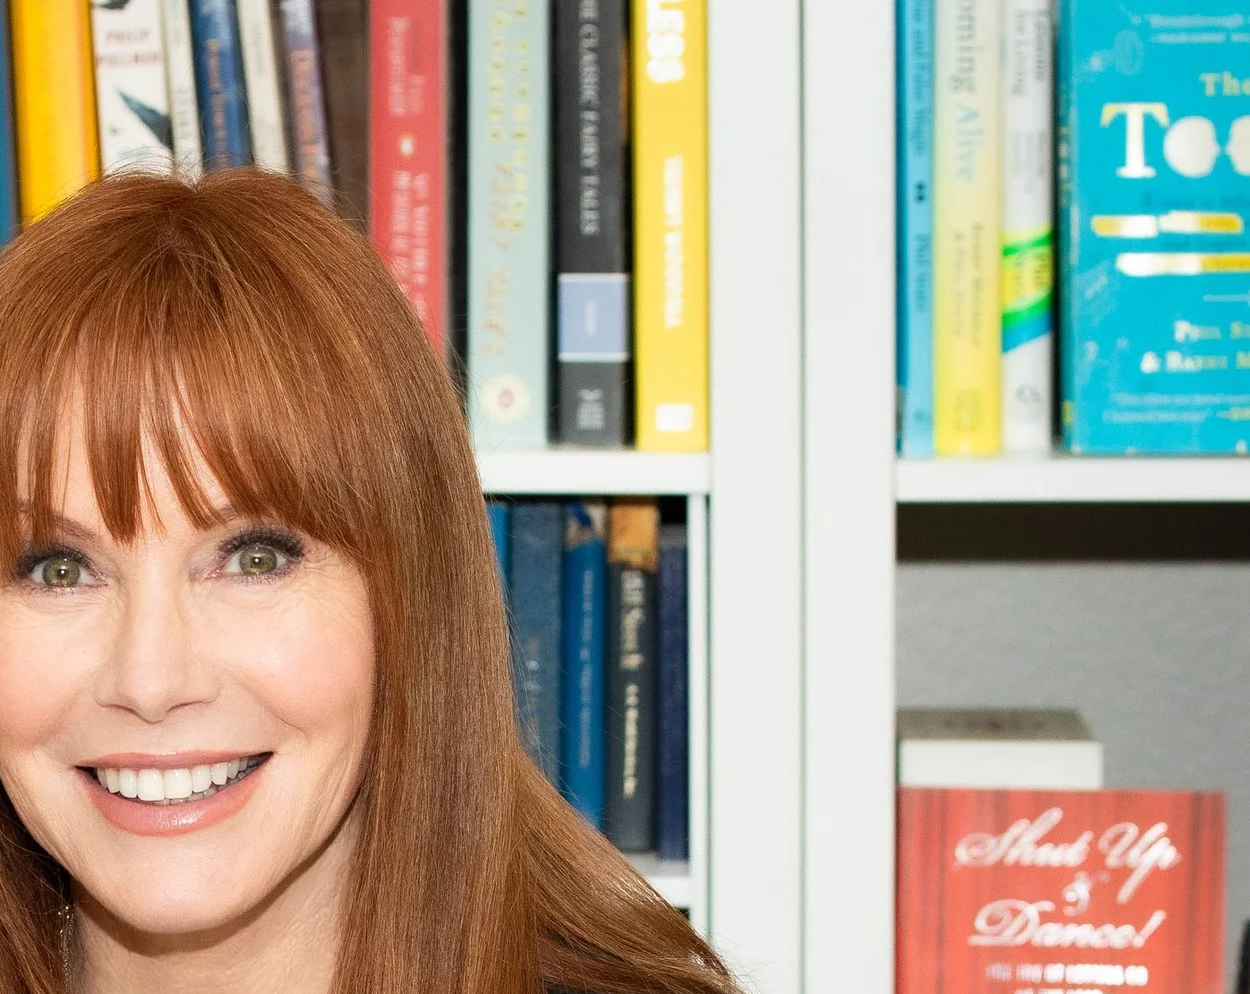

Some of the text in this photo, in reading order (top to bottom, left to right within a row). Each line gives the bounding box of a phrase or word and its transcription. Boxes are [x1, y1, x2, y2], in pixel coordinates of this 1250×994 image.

[953, 806, 1183, 905] Shut Up
[966, 898, 1167, 949] Dance!
